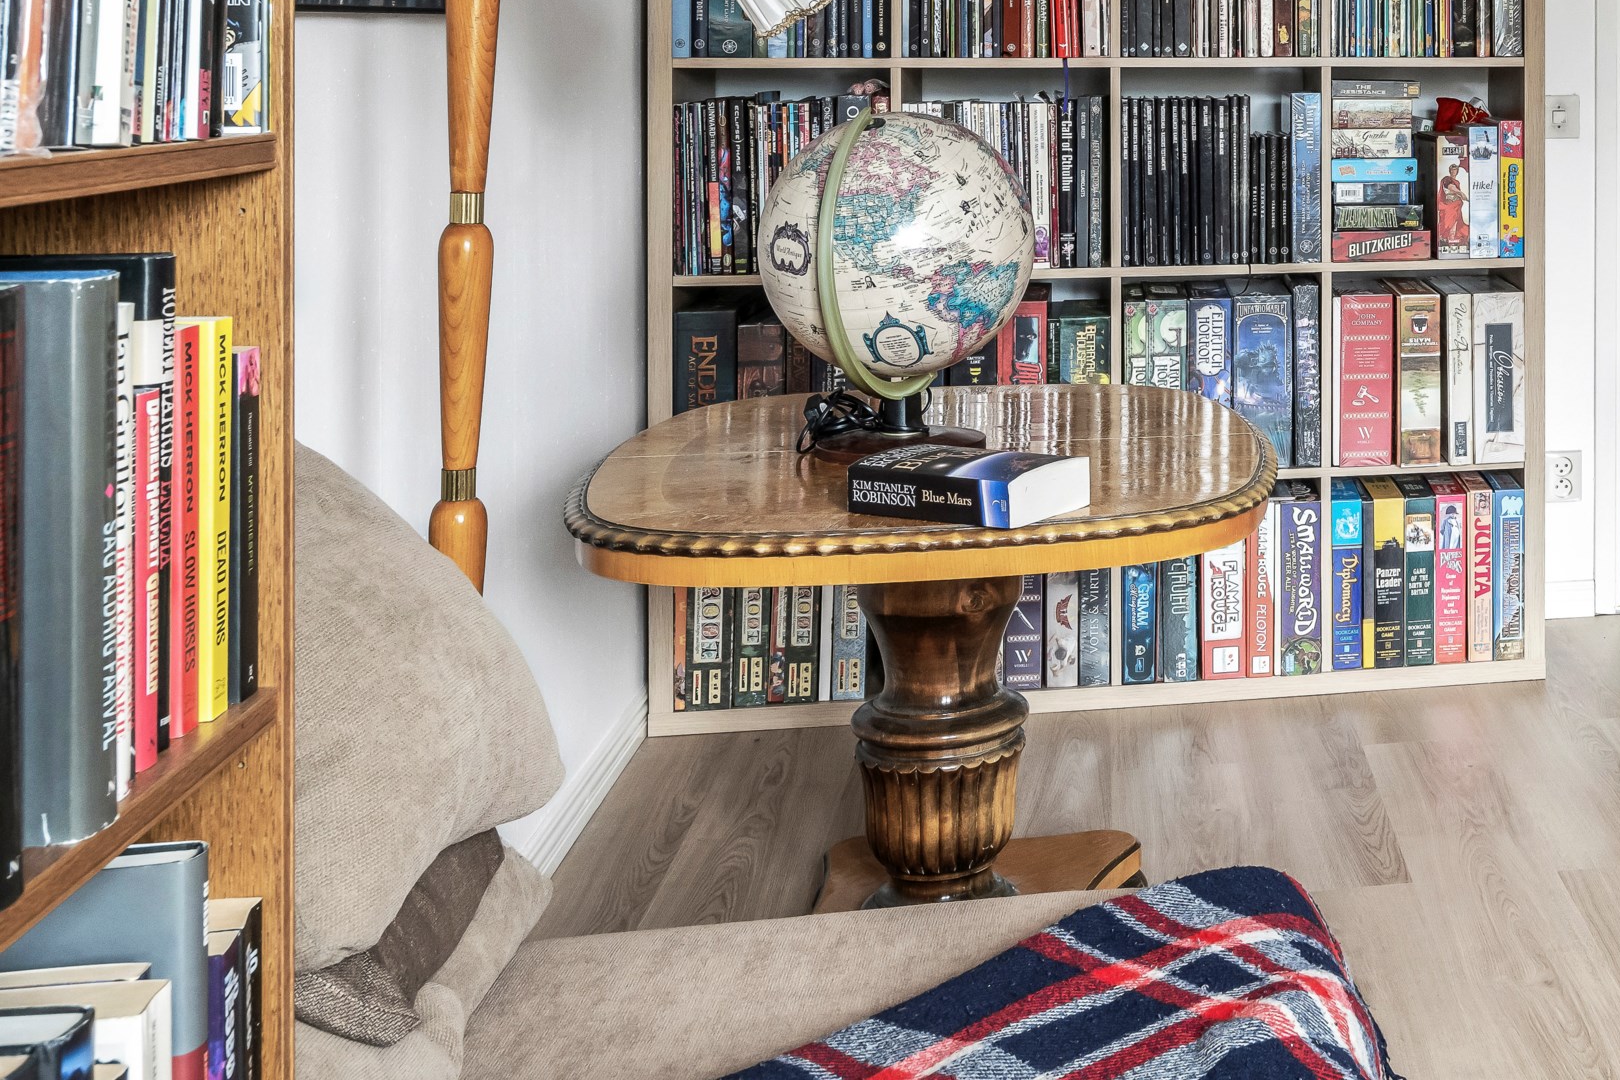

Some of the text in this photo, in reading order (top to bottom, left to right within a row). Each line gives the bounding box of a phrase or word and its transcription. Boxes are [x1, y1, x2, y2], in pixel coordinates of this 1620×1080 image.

[1296, 112, 1305, 141] 2000
[1061, 154, 1073, 192] Cthulhu
[1472, 180, 1494, 191] Hike!
[1508, 164, 1519, 218] Class War
[1349, 232, 1412, 258] BLITZKRIEG!
[1197, 316, 1210, 366] HORROR
[1211, 312, 1223, 369] ELDRITCH
[184, 341, 196, 674] MICK HERRON SLOW HORSES
[215, 334, 227, 646] MICK HERRON DEAD LIONS
[852, 479, 916, 495] KIM STANLEY
[852, 490, 917, 507] ROBINSON
[921, 489, 973, 507] Blue Mars
[1376, 567, 1401, 578] Panzer
[1376, 578, 1402, 588] Leader
[1474, 517, 1491, 599] JUNTA
[1211, 577, 1228, 634] ROUGE
[1223, 560, 1239, 623] FLAMME
[1256, 559, 1267, 652] ROUGE PELOTON
[1335, 553, 1360, 624] Diplomacy
